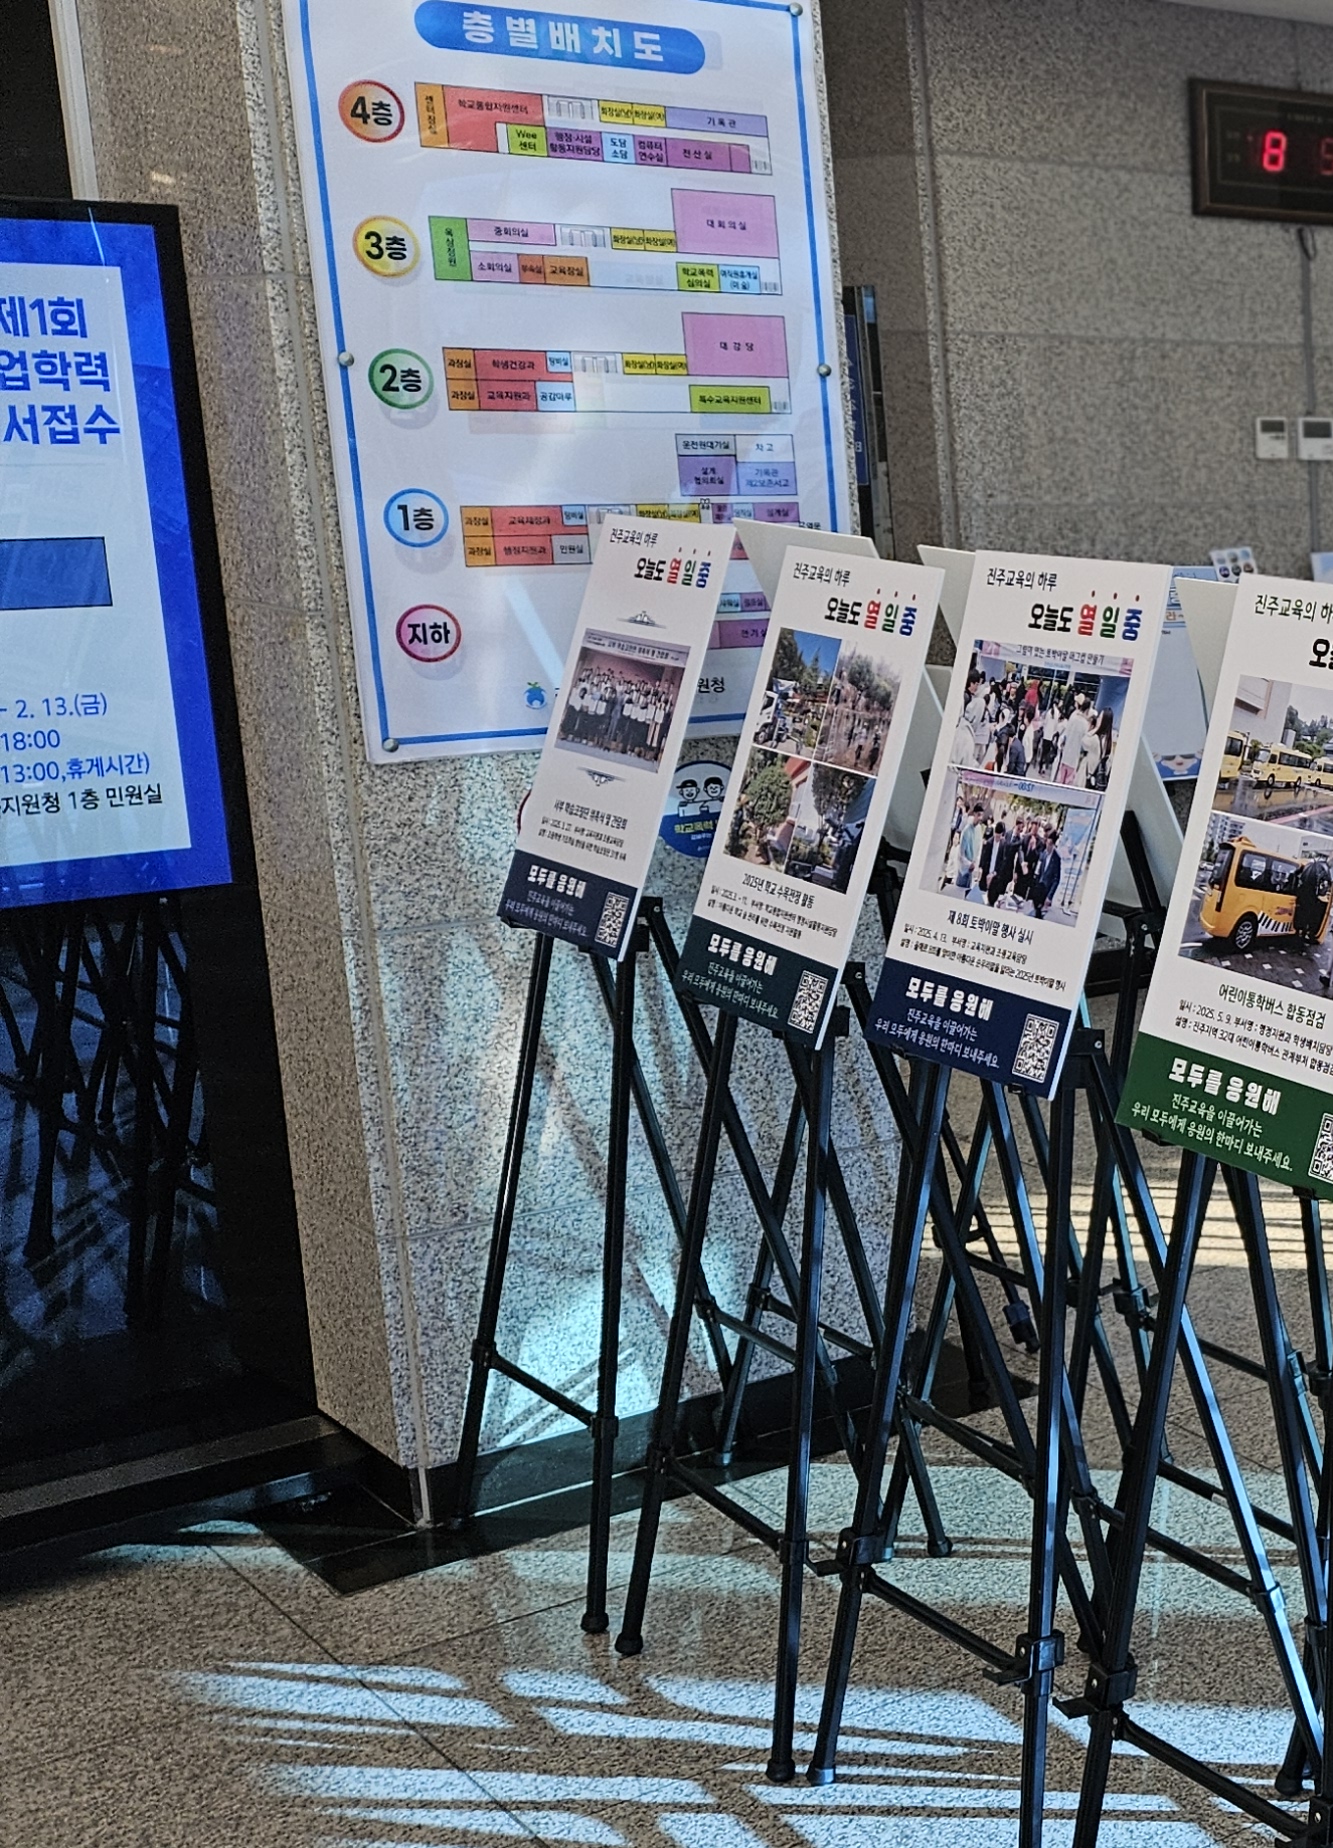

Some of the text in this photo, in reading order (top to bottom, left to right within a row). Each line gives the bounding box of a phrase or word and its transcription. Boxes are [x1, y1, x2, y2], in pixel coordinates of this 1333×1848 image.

[350, 95, 393, 127] 4층
[515, 128, 538, 140] Wee
[519, 142, 537, 151] 센터
[1262, 130, 1287, 172] 8
[364, 231, 408, 262] 3층
[477, 261, 512, 273] 소회의실
[550, 265, 584, 277] 교육장실
[0, 296, 88, 338] 제1회
[0, 350, 111, 392] 업학력
[379, 364, 422, 393] 2층
[3, 404, 121, 445] 서접수
[397, 504, 434, 532] 1층
[609, 526, 658, 548] 진주교육의 하루
[633, 556, 666, 584] 오늘도
[793, 561, 850, 588] 진주교육의 하루
[986, 567, 1058, 592] 진주교육의 하루
[823, 596, 862, 627] 오늘도
[1028, 603, 1074, 633] 오늘도
[1254, 594, 1318, 622] 진주교육의
[407, 622, 451, 647] 지하
[15, 692, 108, 719] 2. 13.(금)
[68, 788, 100, 811] 1층
[106, 783, 163, 809] 민원실
[527, 864, 587, 900] 모두를 응원해
[707, 933, 779, 976] 모두를 응원해
[905, 976, 995, 1022] 모두를 응원해
[1218, 983, 1327, 1030] 어린이통학버스 합동점검
[1168, 1056, 1282, 1115] 모두를 응원해
